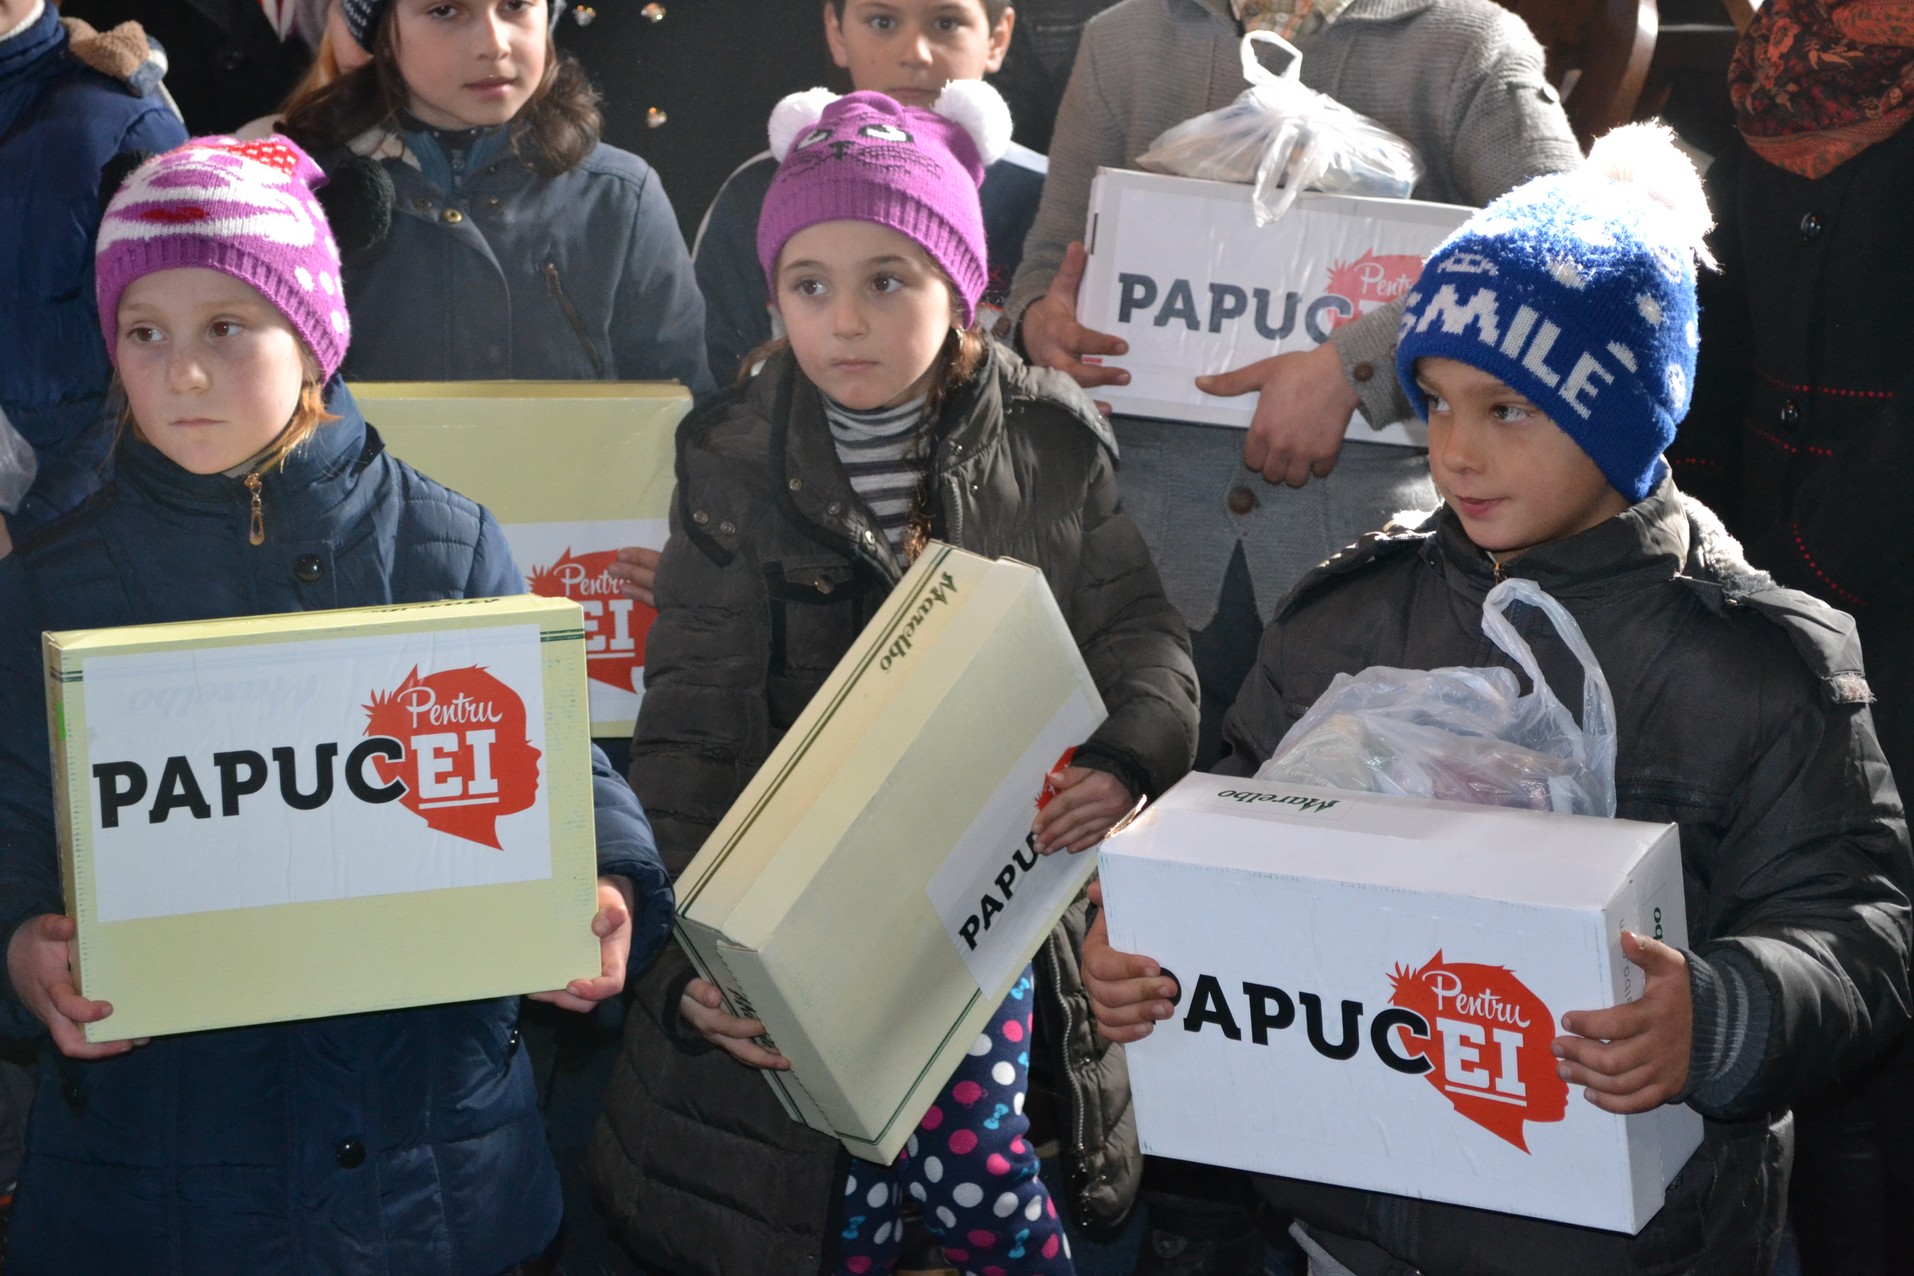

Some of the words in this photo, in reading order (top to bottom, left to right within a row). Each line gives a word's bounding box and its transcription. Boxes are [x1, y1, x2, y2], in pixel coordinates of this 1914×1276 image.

[553, 563, 628, 596] Pentr
[880, 571, 957, 671] Marelbo
[397, 686, 502, 729] Pentru
[1218, 789, 1341, 813] Marelbo
[958, 831, 1039, 951] PAPU
[1422, 970, 1531, 1028] Pentru
